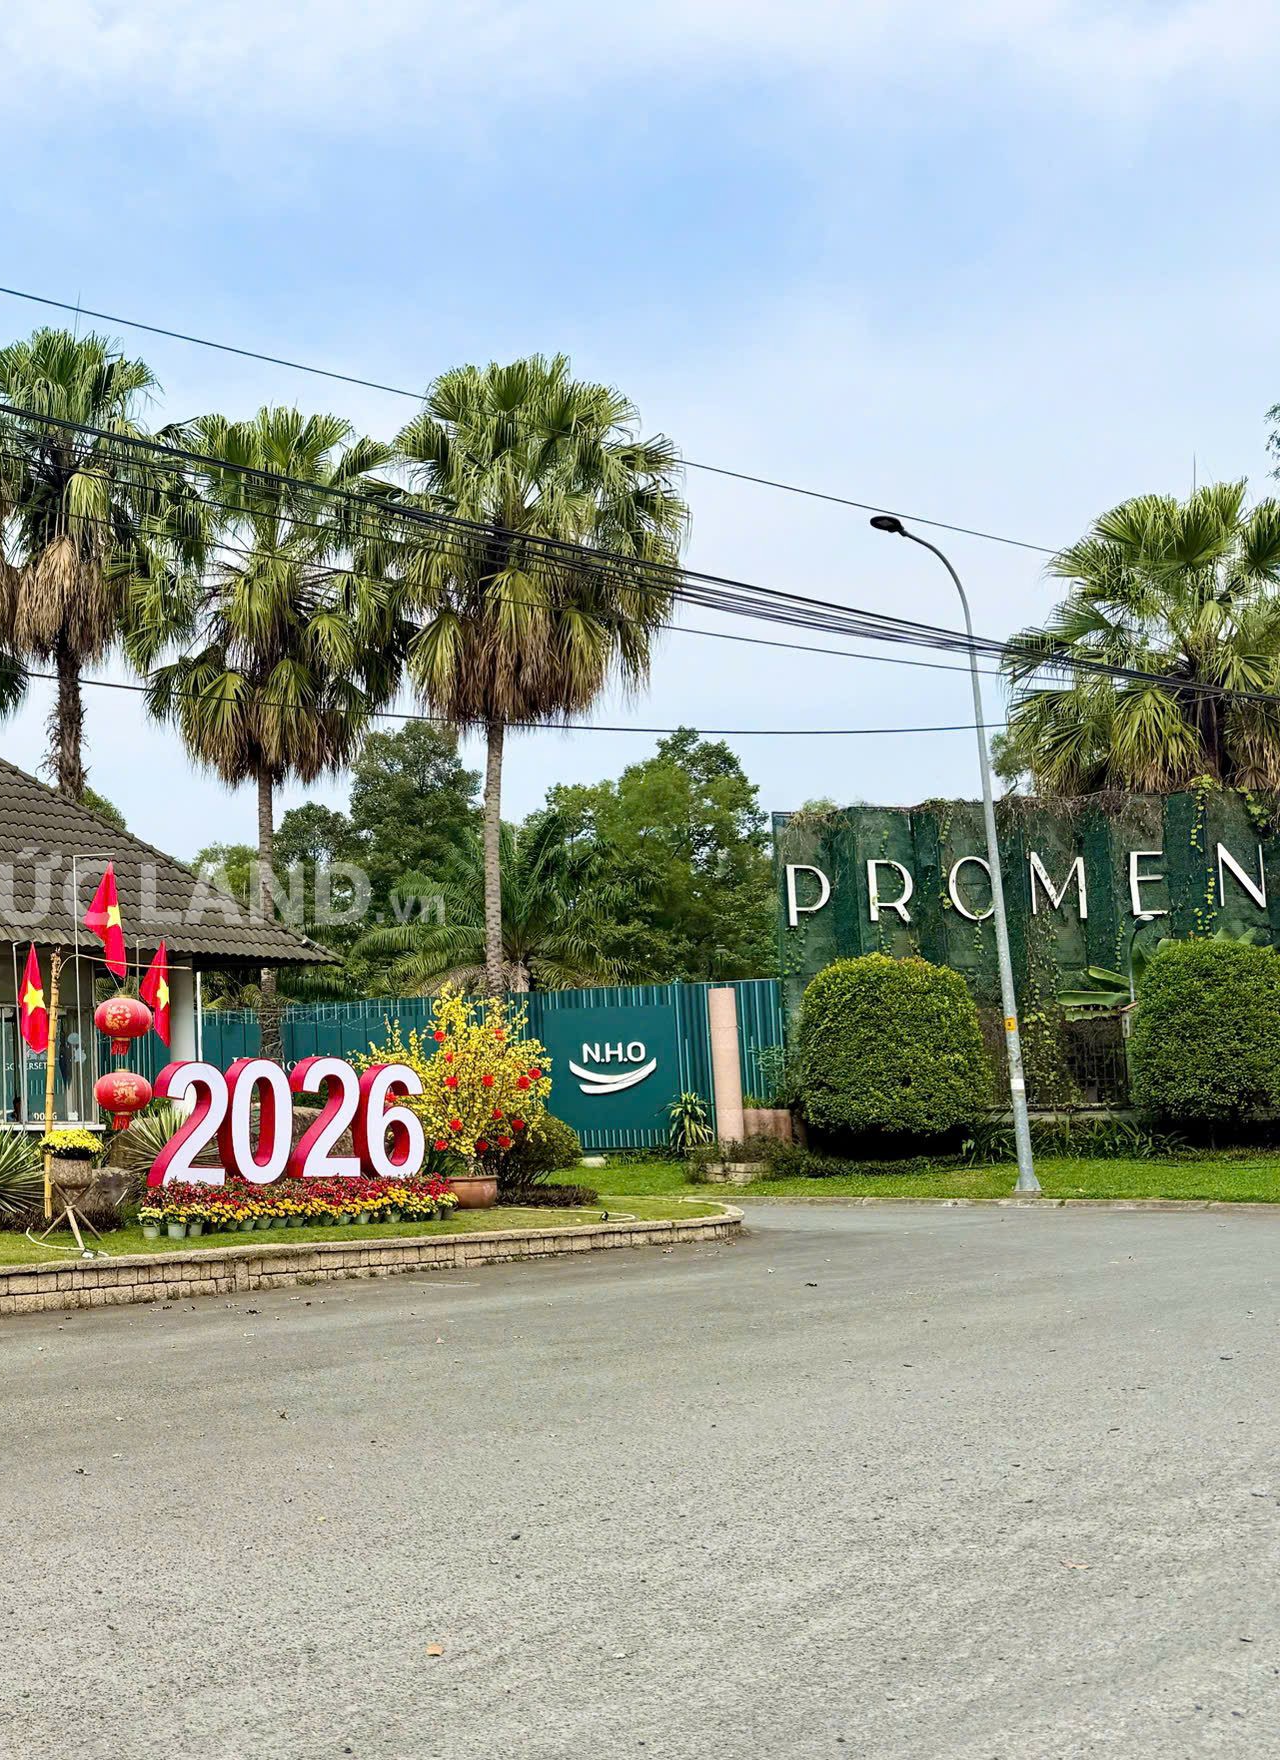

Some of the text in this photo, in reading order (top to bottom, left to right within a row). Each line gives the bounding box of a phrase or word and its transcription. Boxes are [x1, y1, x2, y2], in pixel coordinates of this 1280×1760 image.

[784, 841, 1268, 928] PROMEN
[582, 1041, 646, 1064] N.H.O
[147, 1056, 426, 1187] 2026
